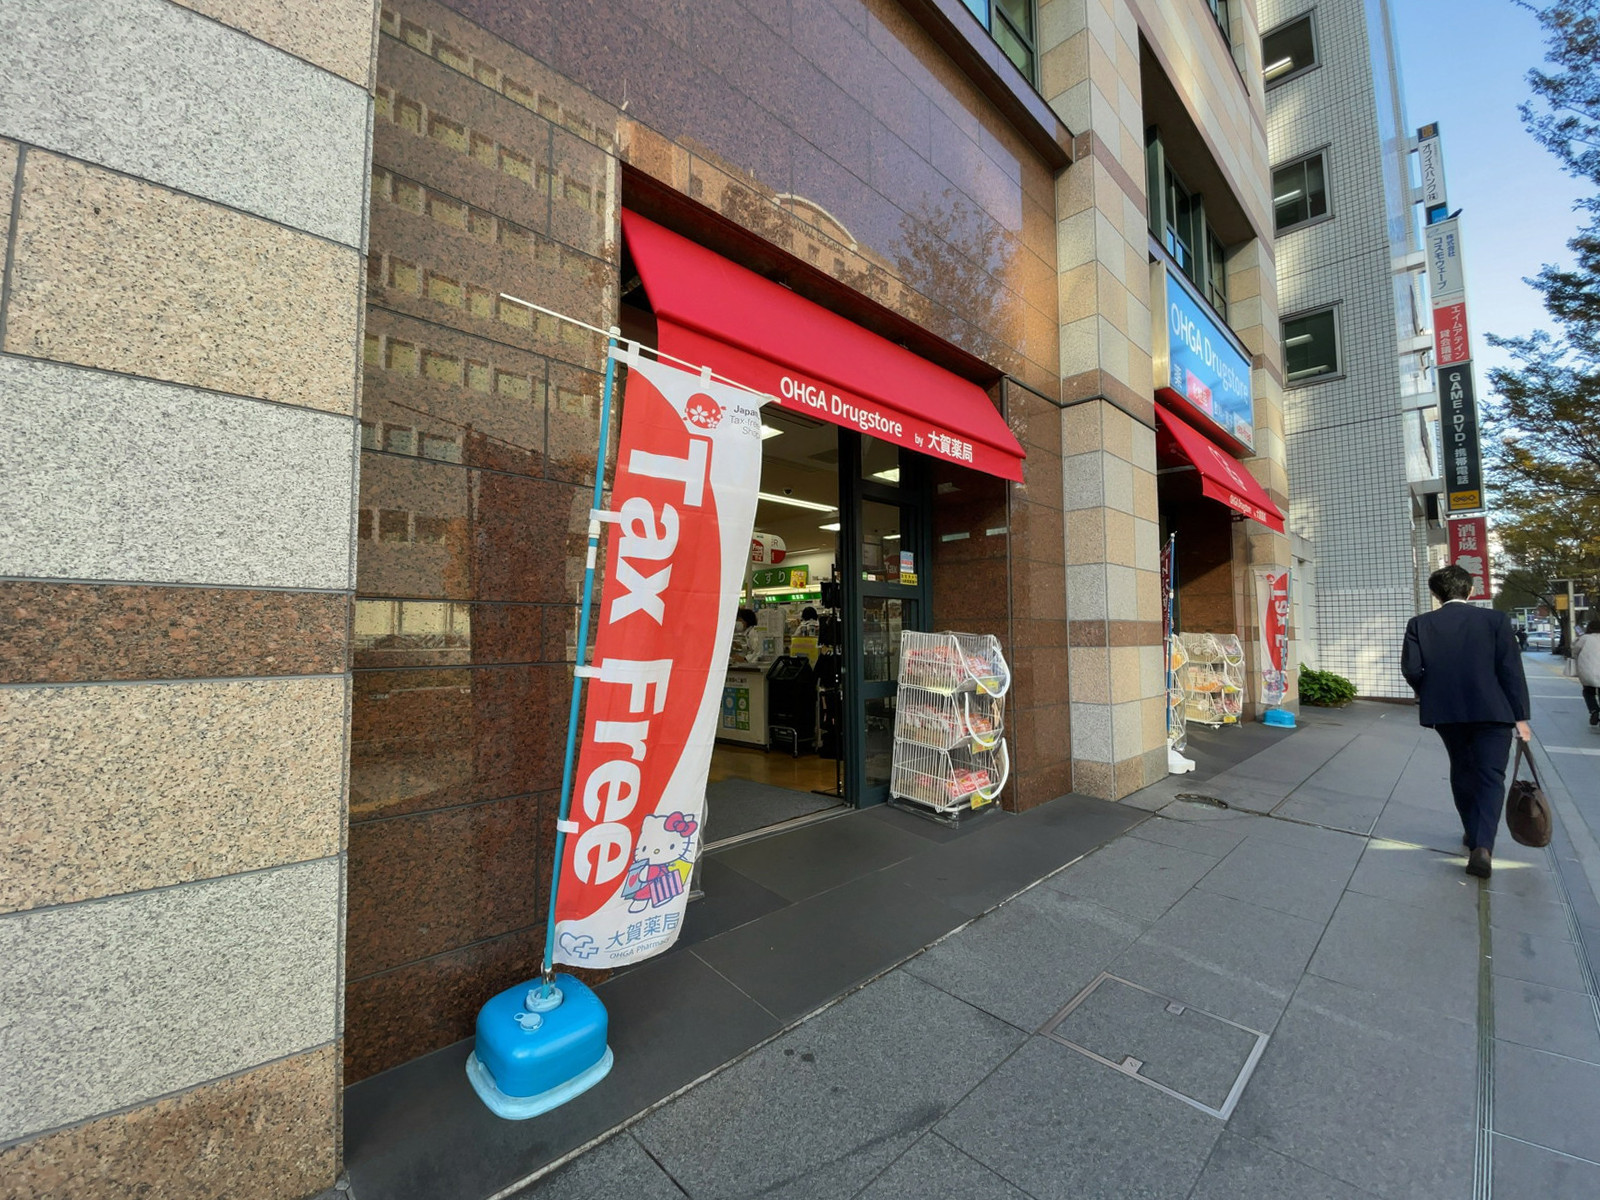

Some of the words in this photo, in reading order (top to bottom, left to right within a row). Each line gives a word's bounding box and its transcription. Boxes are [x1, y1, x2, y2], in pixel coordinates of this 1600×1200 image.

[1170, 302, 1204, 360] OHGA
[1204, 336, 1249, 405] Drugstore
[780, 376, 828, 412] OHGA
[831, 394, 903, 437] Drugstore
[914, 433, 924, 448] by
[927, 430, 974, 463] 大賀薬局
[609, 438, 709, 627] Tax
[752, 570, 786, 587] くすり
[573, 657, 673, 886] Free
[605, 911, 680, 950] 大賀薬局
[609, 948, 635, 960] OHGA
